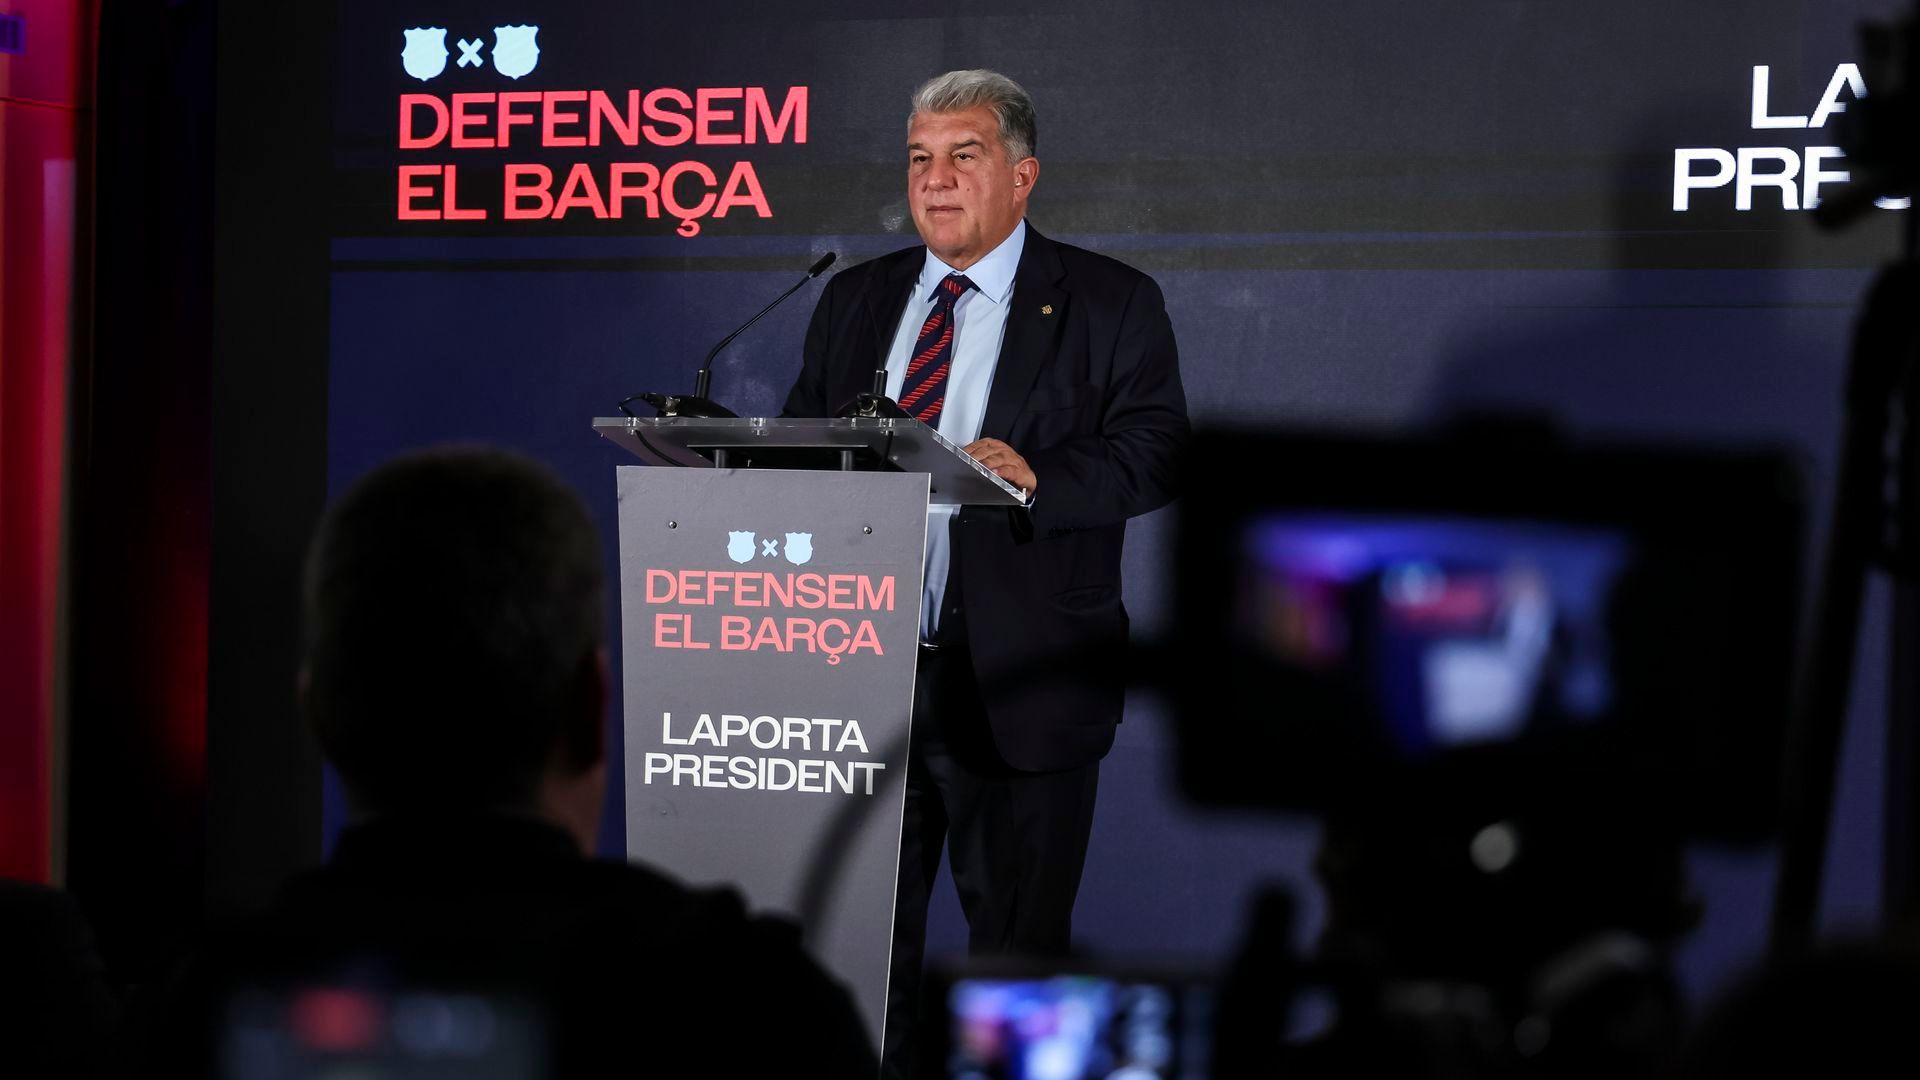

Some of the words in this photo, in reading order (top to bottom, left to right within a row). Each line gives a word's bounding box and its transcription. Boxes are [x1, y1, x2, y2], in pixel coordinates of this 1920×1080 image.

[399, 86, 808, 149] DEFENSEM
[1751, 63, 1868, 129] LA
[398, 164, 487, 220] EL
[504, 160, 773, 237] BARÇA
[1673, 146, 1911, 211] PRE
[645, 569, 895, 611] DEFENSEM
[654, 613, 710, 649] EL
[720, 615, 884, 665] BARÇA
[662, 712, 869, 753] LAPORTA
[644, 752, 886, 795] PRESIDENT
